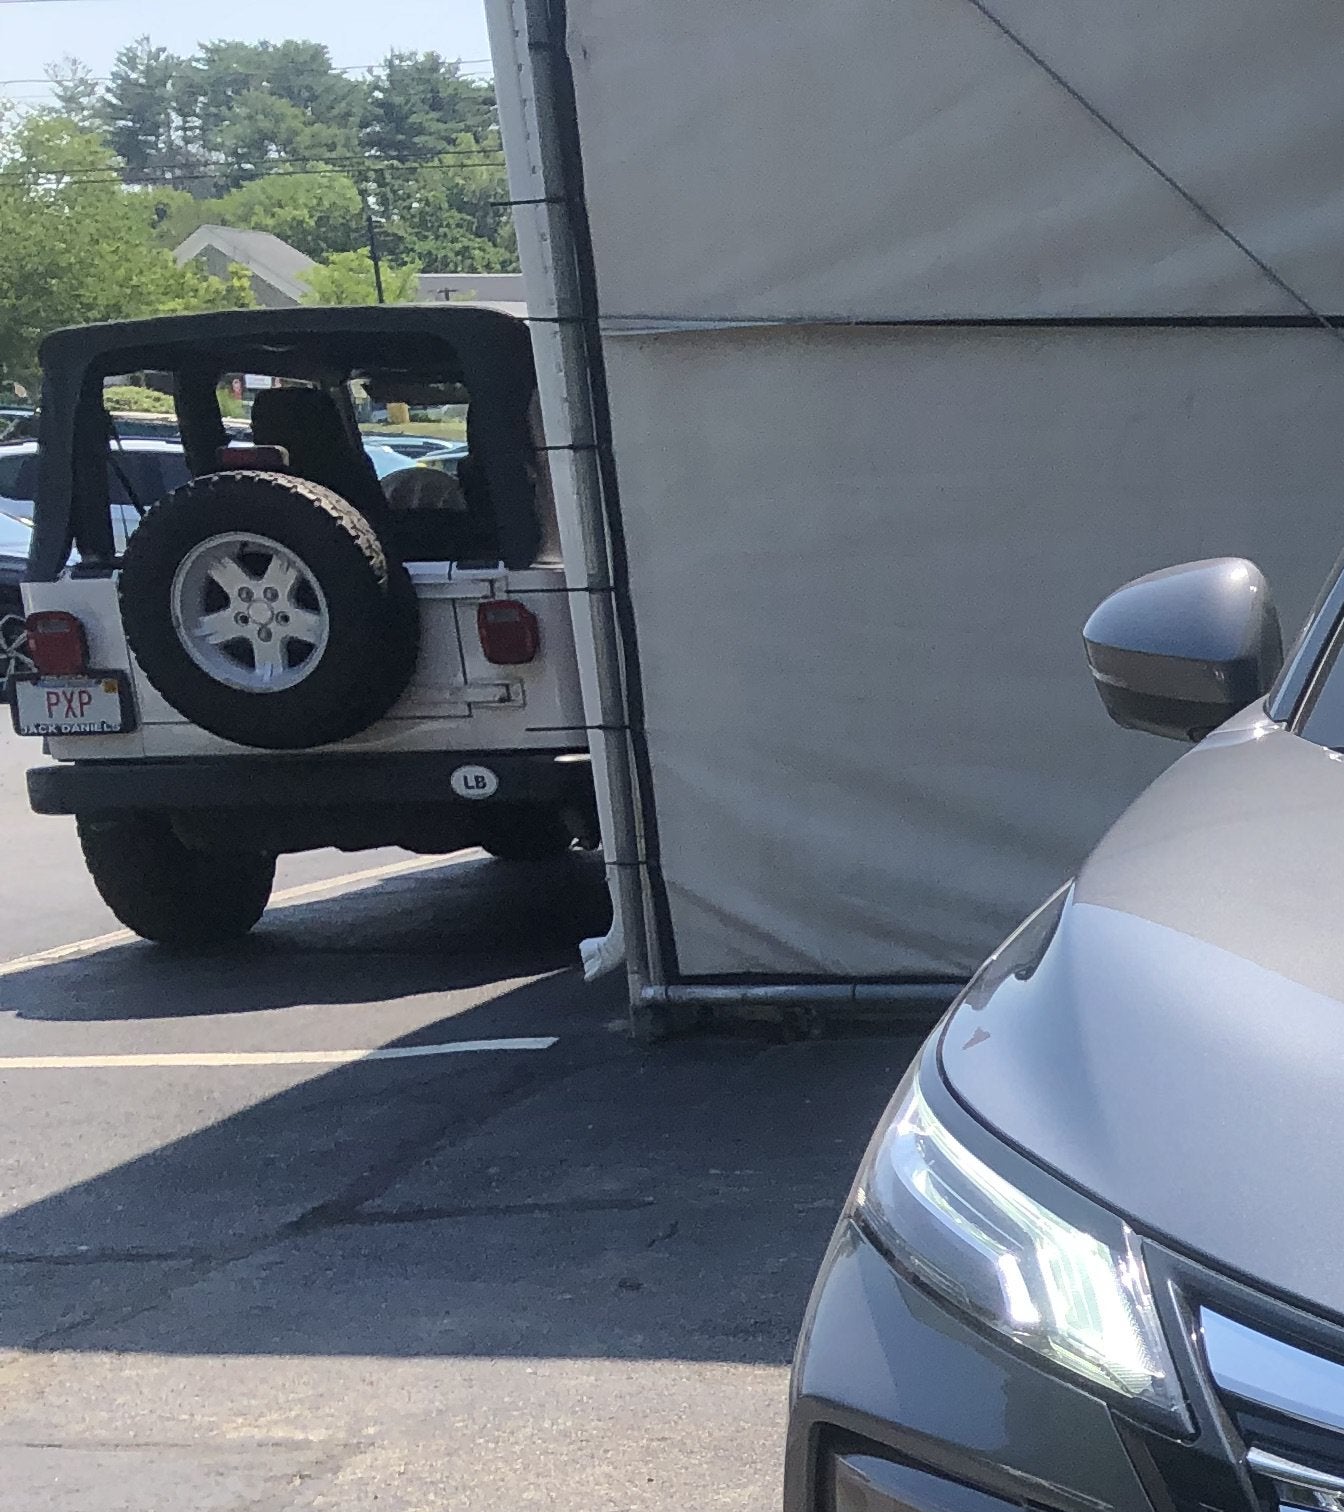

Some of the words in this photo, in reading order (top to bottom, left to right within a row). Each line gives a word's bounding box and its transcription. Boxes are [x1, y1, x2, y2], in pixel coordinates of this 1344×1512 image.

[46, 689, 93, 719] PXP
[21, 723, 58, 734] JACK
[463, 774, 487, 790] LB
